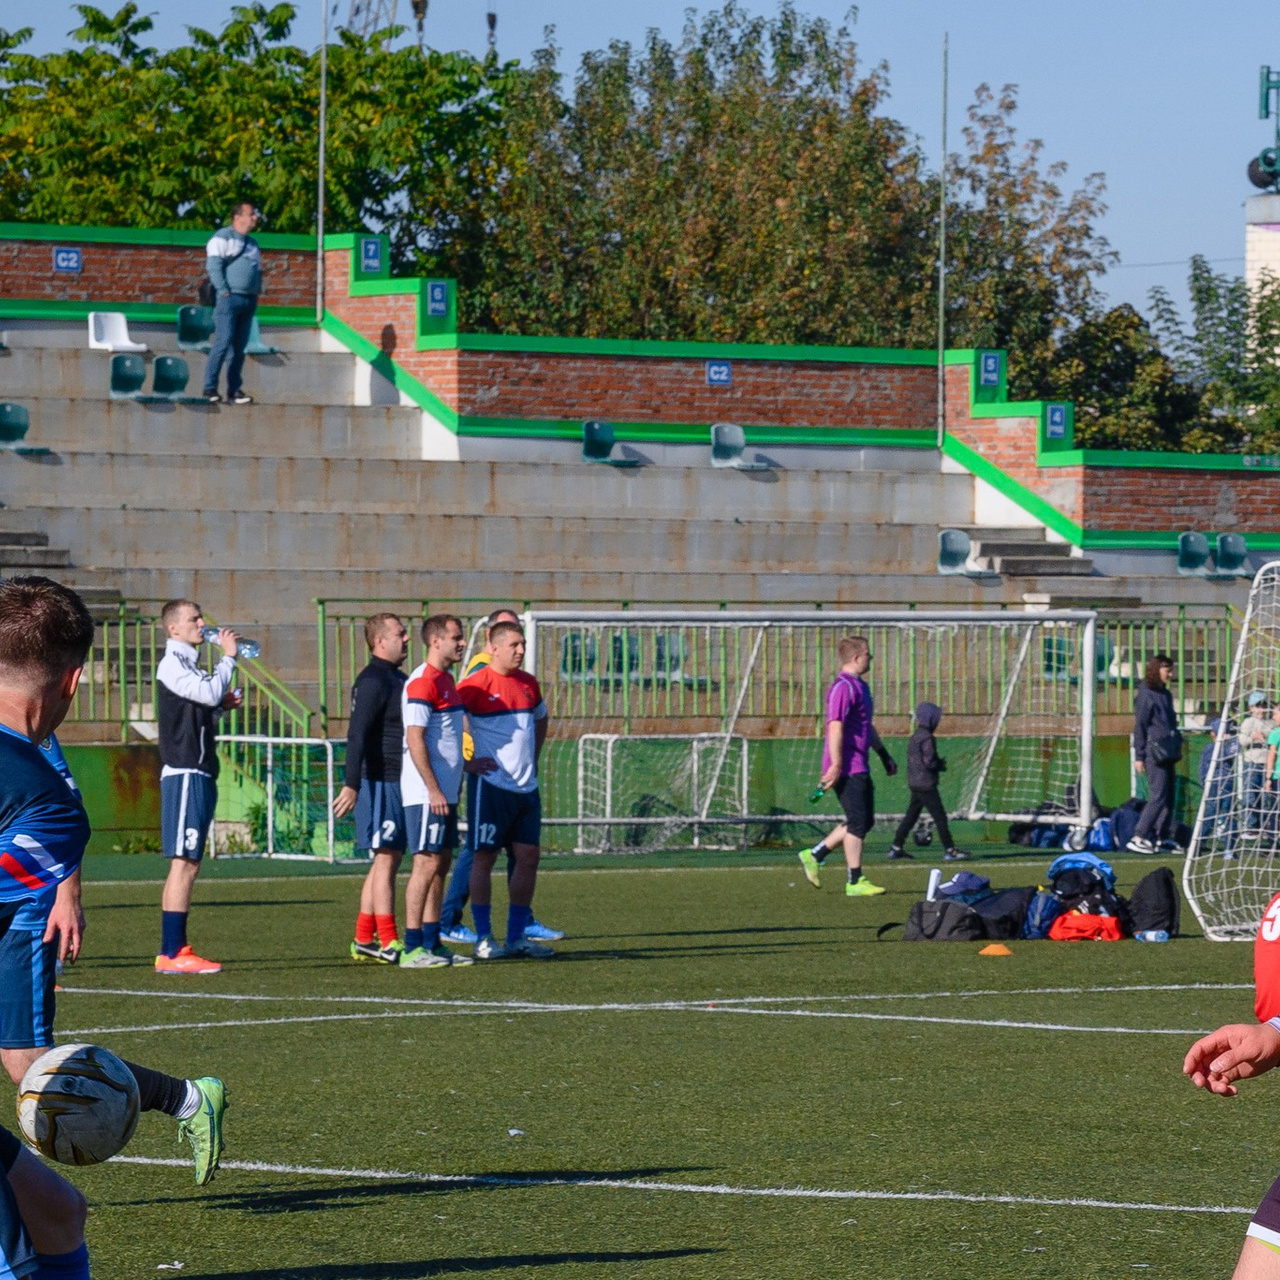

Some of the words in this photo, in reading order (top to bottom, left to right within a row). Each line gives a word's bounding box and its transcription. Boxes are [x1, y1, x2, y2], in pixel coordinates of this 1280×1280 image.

[185, 827, 199, 851] 3
[382, 819, 396, 841] 2
[428, 822, 446, 845] 11
[479, 822, 497, 844] 12
